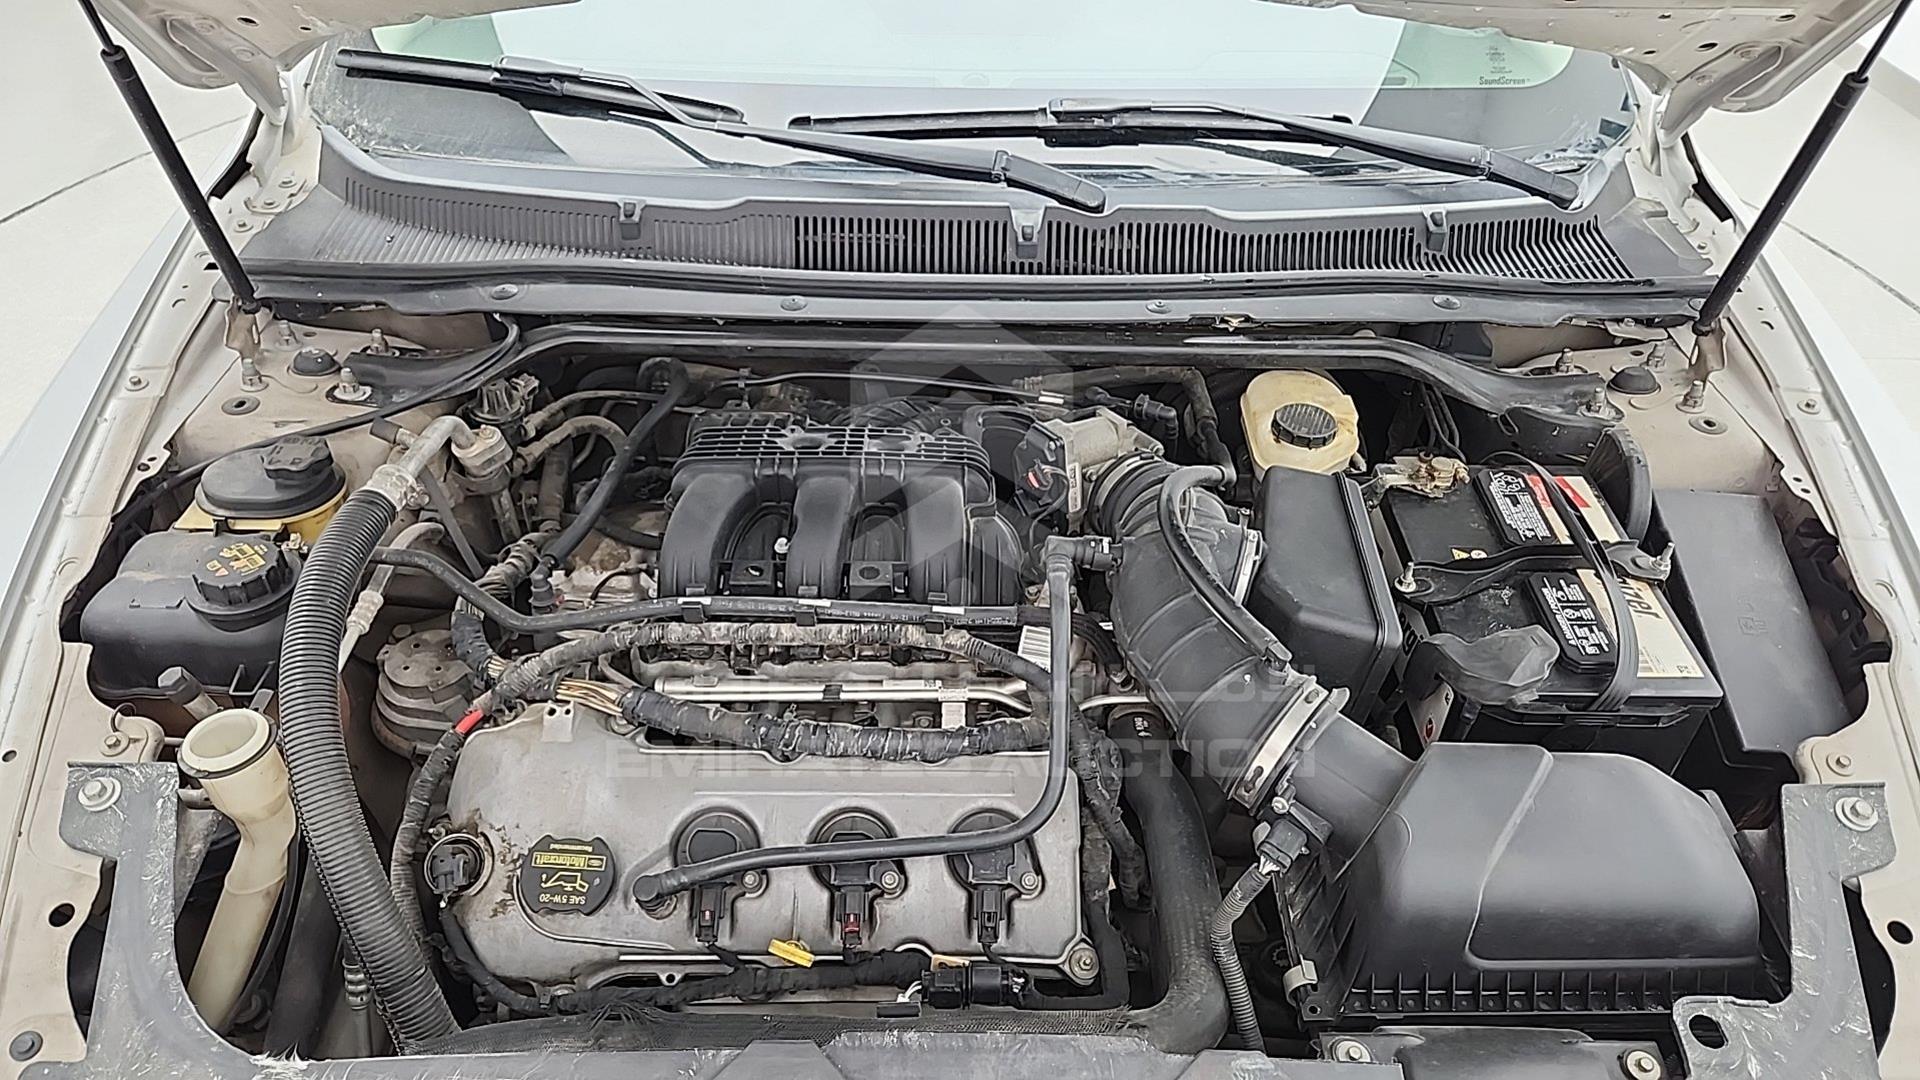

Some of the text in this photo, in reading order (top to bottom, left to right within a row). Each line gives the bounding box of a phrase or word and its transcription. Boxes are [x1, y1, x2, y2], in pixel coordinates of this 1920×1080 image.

[1479, 76, 1526, 85] SoundScreen
[536, 854, 585, 867] Motorcraft
[568, 894, 586, 905] SAE
